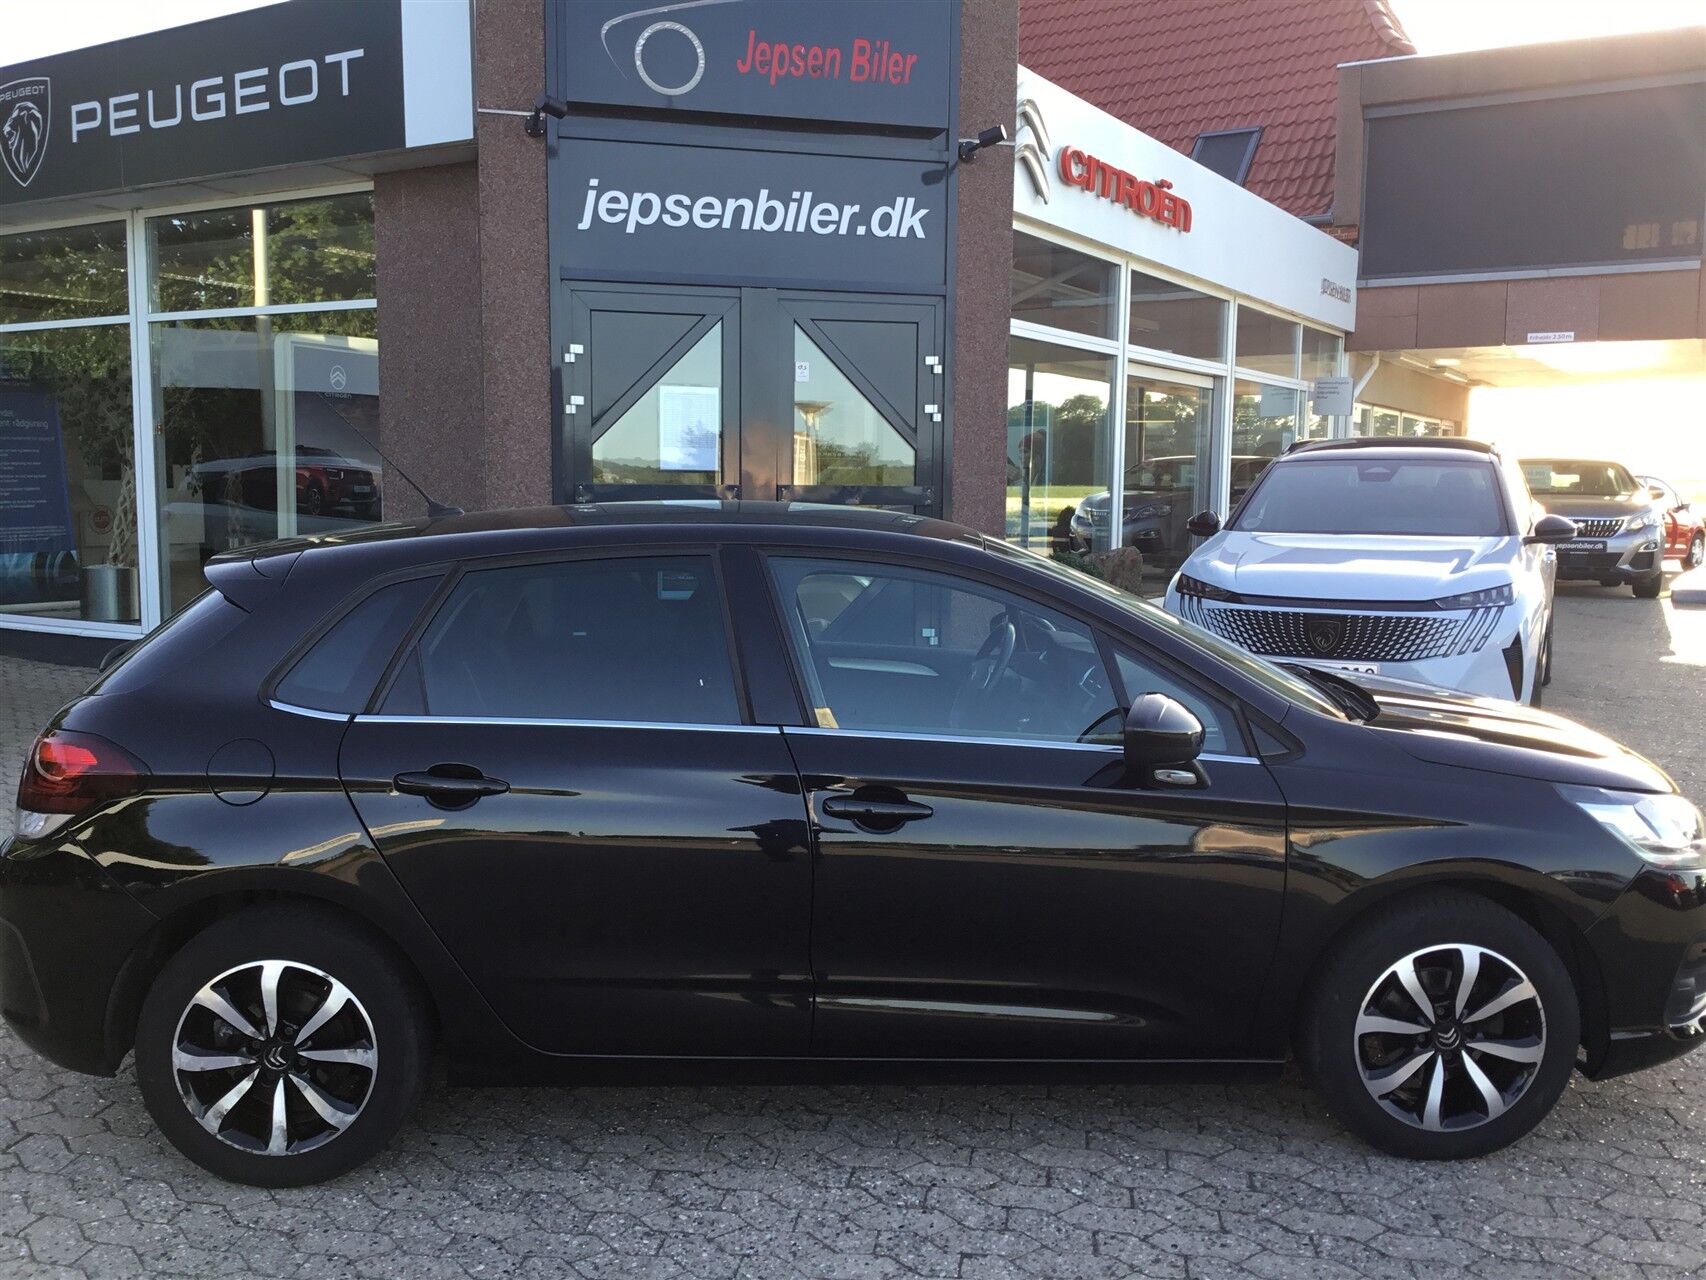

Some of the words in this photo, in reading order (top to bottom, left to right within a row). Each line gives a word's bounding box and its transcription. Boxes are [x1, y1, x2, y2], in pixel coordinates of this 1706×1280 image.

[736, 29, 842, 87] Jepsen
[850, 37, 918, 85] Biler
[0, 85, 46, 101] PEUGEOT
[71, 48, 365, 143] PEUGEOT
[577, 178, 930, 240] jepsenbiler.dk
